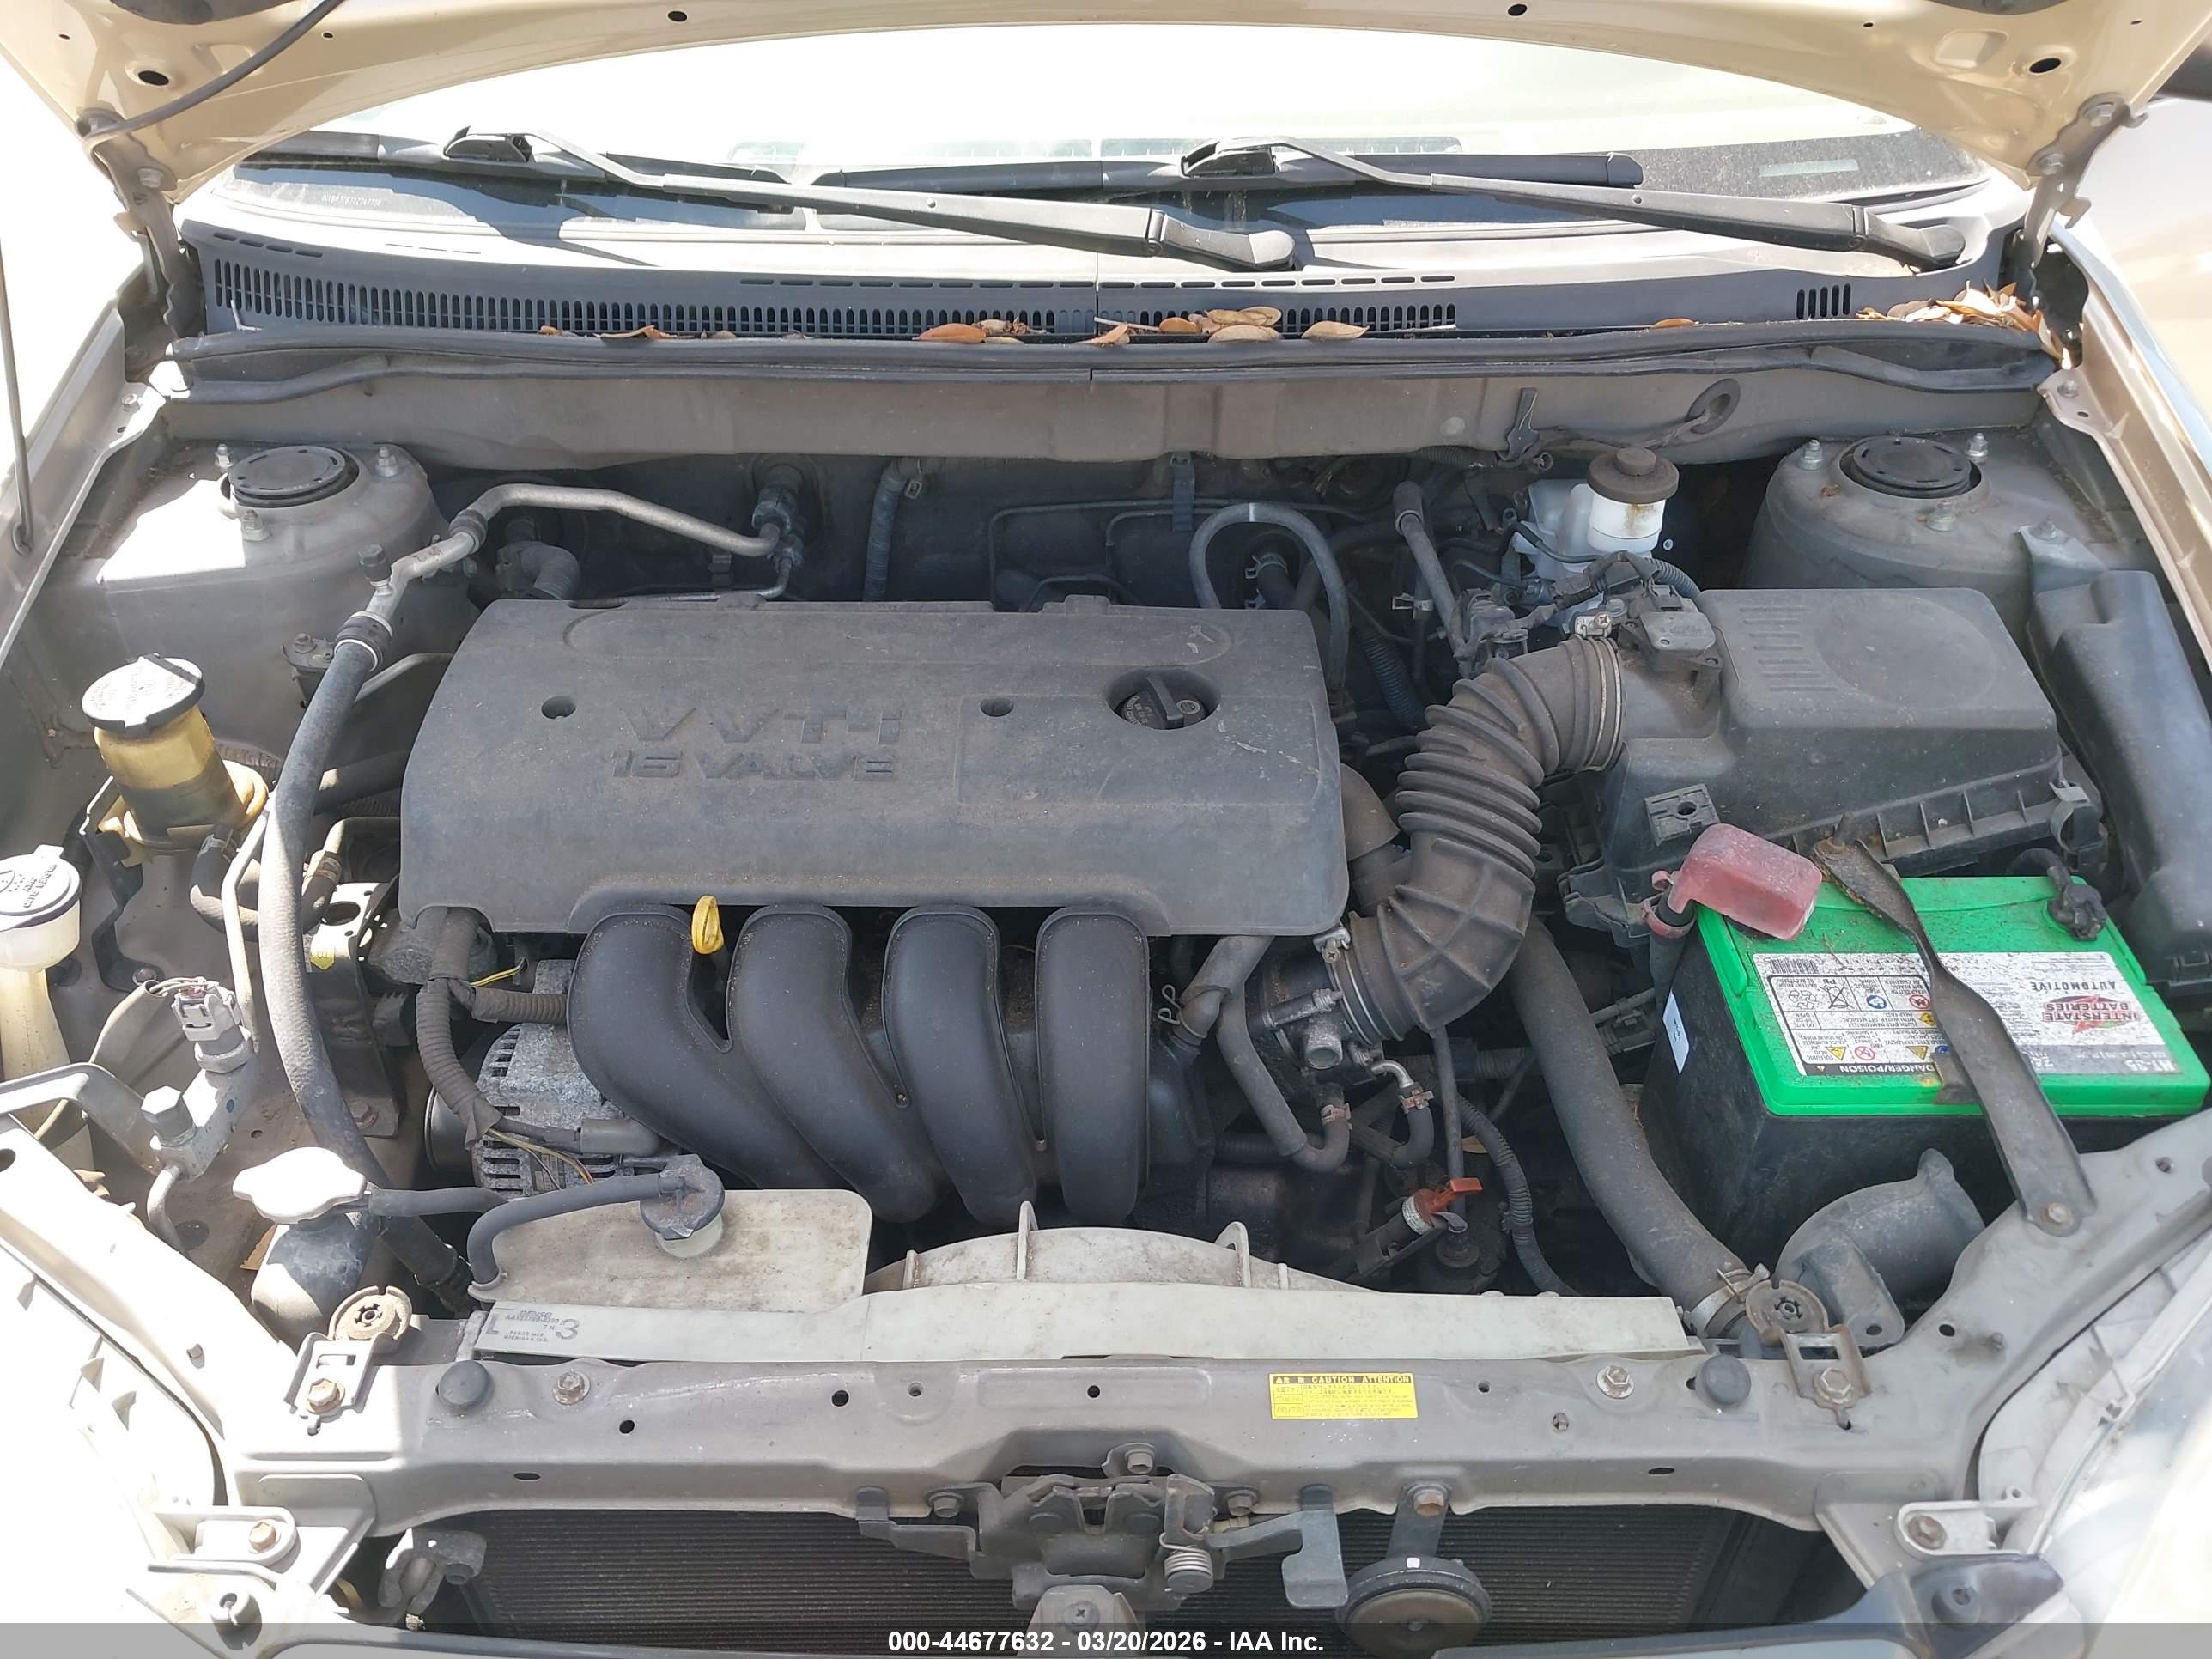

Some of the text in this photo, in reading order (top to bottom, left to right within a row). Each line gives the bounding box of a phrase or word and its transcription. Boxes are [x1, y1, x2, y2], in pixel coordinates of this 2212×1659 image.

[611, 750, 896, 781] 16 VALVE
[2030, 981, 2116, 991] AUTOMOTIVE
[2045, 1002, 2129, 1012] BATTERIES
[2042, 1012, 2137, 1022] INTERSTATE
[1838, 1064, 1934, 1073] DANGER/POISON
[556, 1318, 580, 1340] 3
